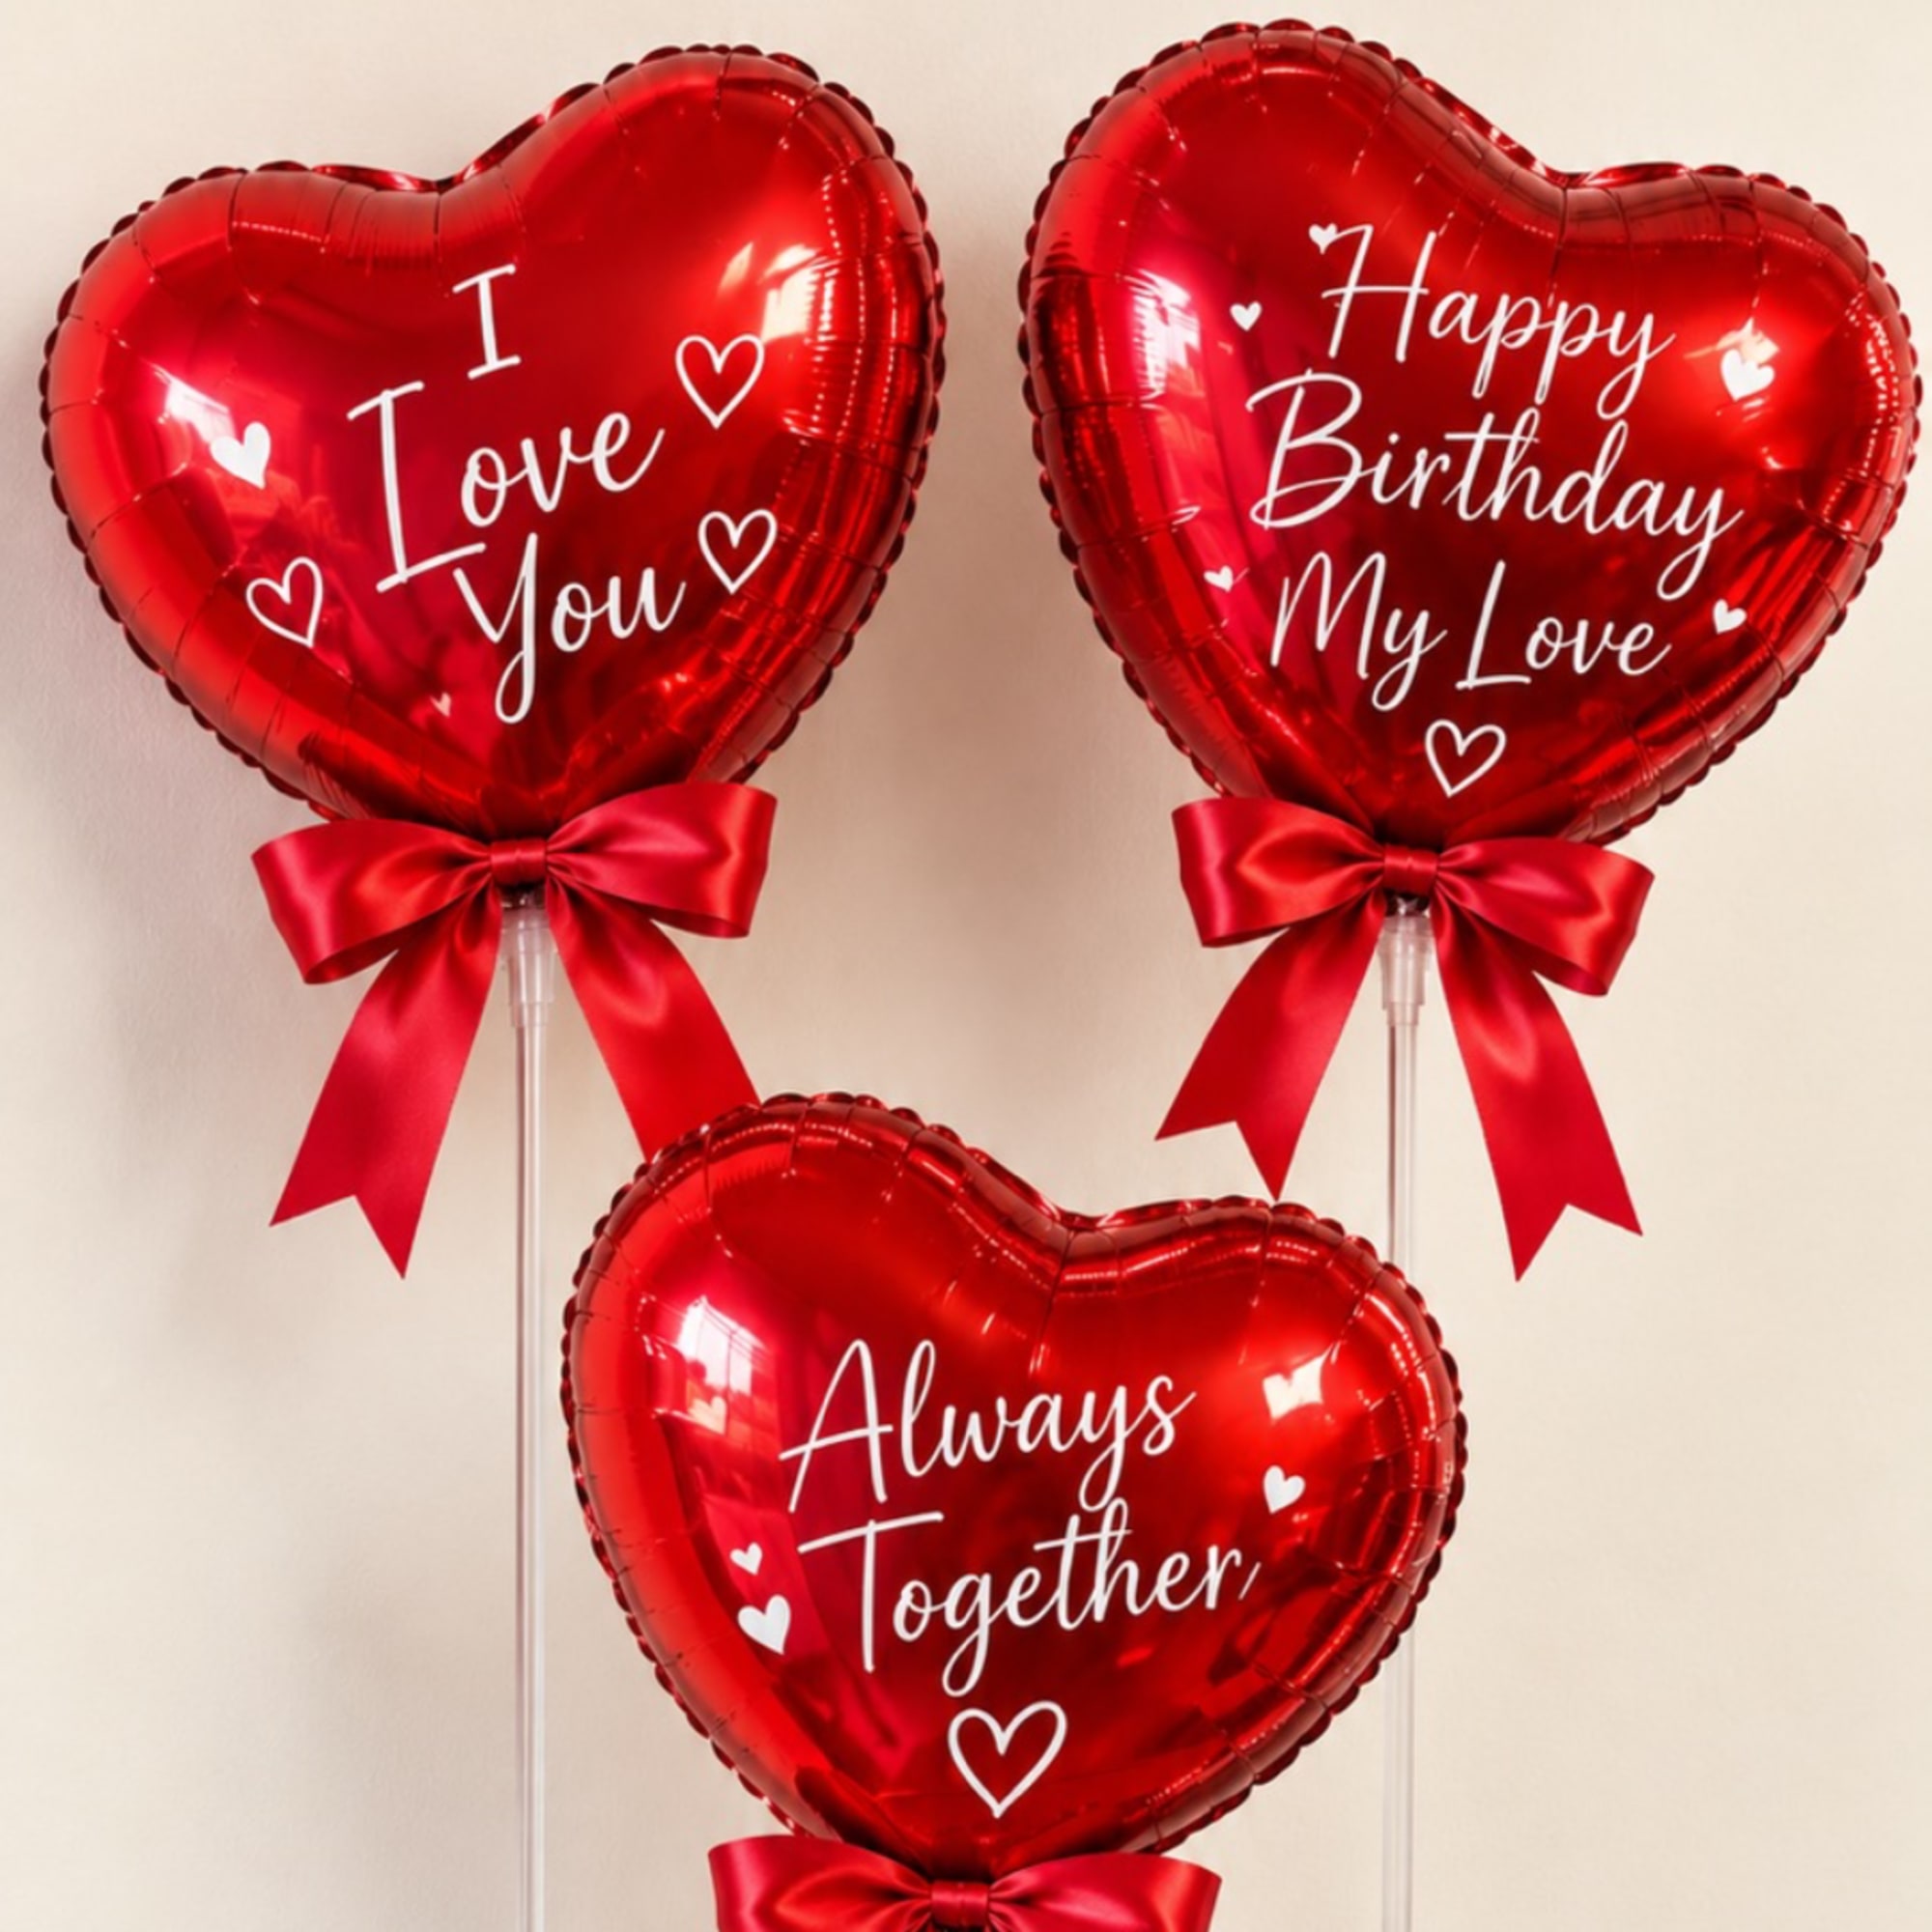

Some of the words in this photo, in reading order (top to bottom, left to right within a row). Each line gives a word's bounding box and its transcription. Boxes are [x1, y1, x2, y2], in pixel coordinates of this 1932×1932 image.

[452, 264, 521, 379] I
[1321, 223, 1676, 420] Happy
[347, 381, 666, 593] Love
[1245, 368, 1745, 601] Birthday
[453, 532, 687, 724] You
[1270, 552, 1448, 712] My
[1456, 560, 1672, 691] Love
[779, 1339, 1197, 1513] Always
[797, 1496, 1261, 1697] Together
